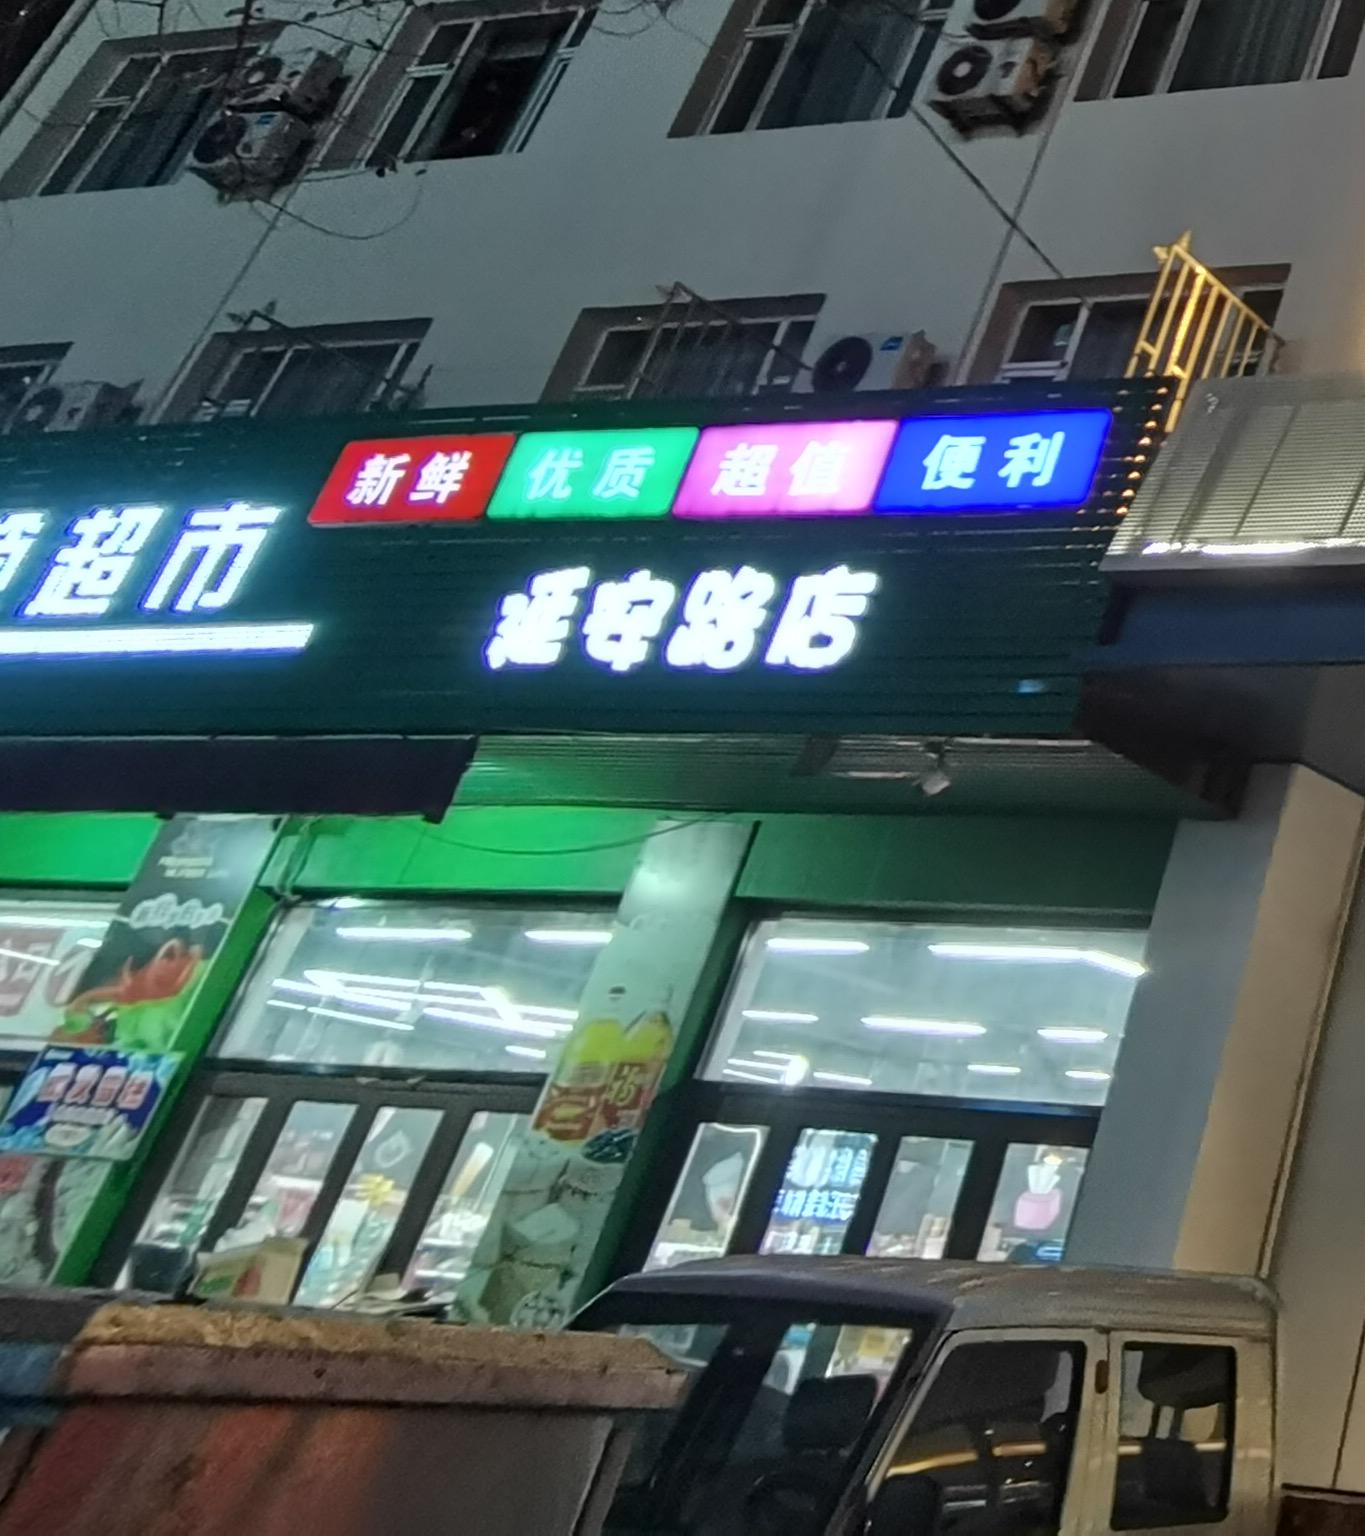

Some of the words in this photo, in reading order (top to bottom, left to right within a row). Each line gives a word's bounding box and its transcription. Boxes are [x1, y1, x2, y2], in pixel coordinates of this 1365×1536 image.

[345, 450, 474, 508] 新鲜
[523, 444, 657, 502] 优质
[710, 437, 854, 498] 超值
[920, 430, 1067, 490] 便利
[485, 564, 881, 673] 延安路店
